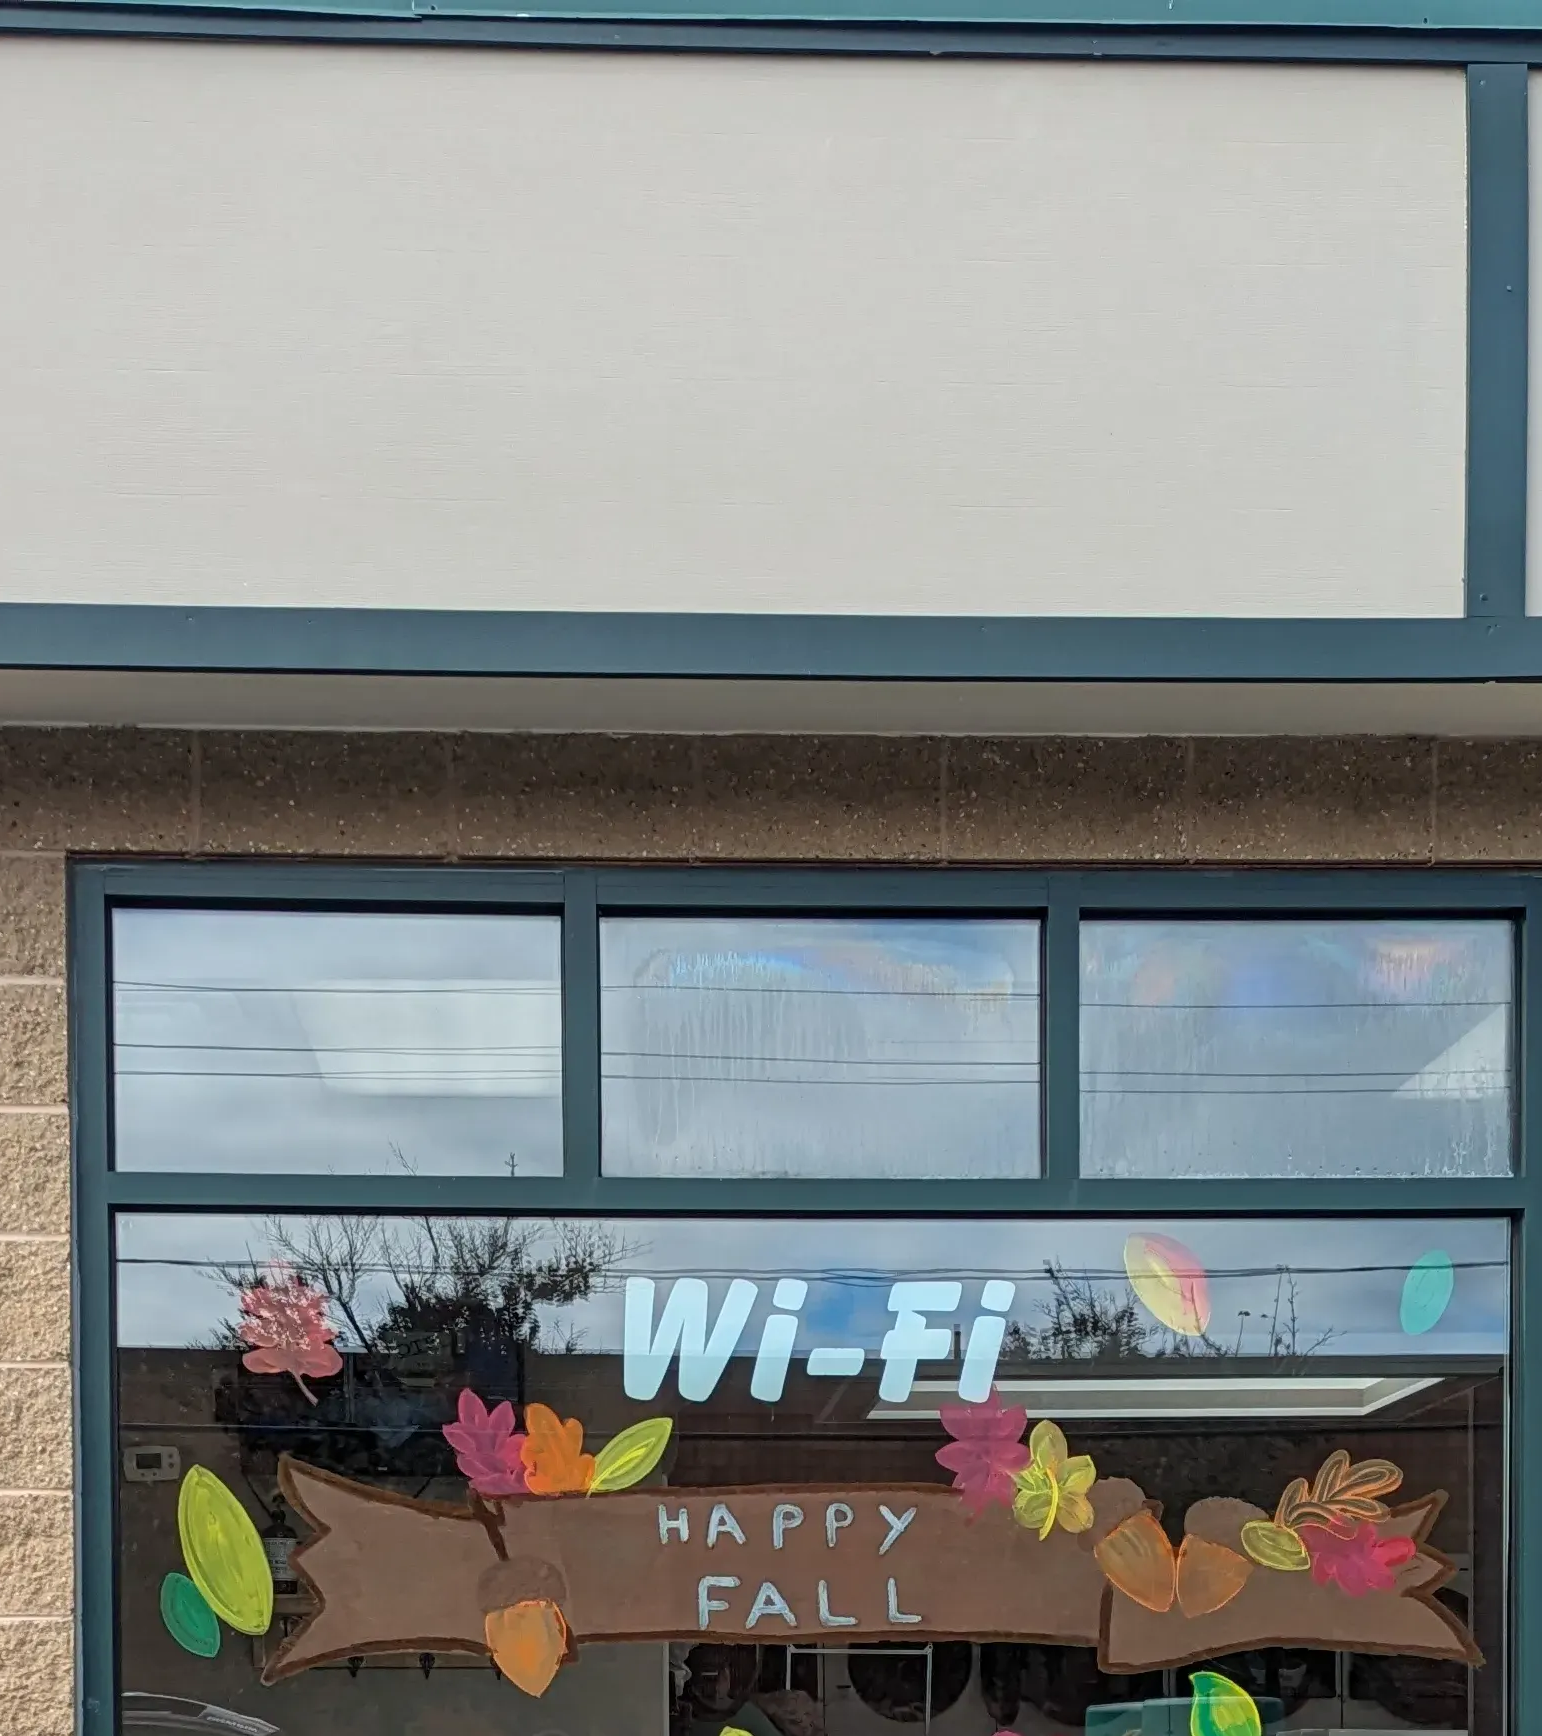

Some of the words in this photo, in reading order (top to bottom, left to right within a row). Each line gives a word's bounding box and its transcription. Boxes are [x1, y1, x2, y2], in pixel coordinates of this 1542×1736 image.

[622, 1276, 1016, 1404] Wi-Fi
[658, 1502, 917, 1556] HAPPY
[697, 1574, 923, 1631] FALL
